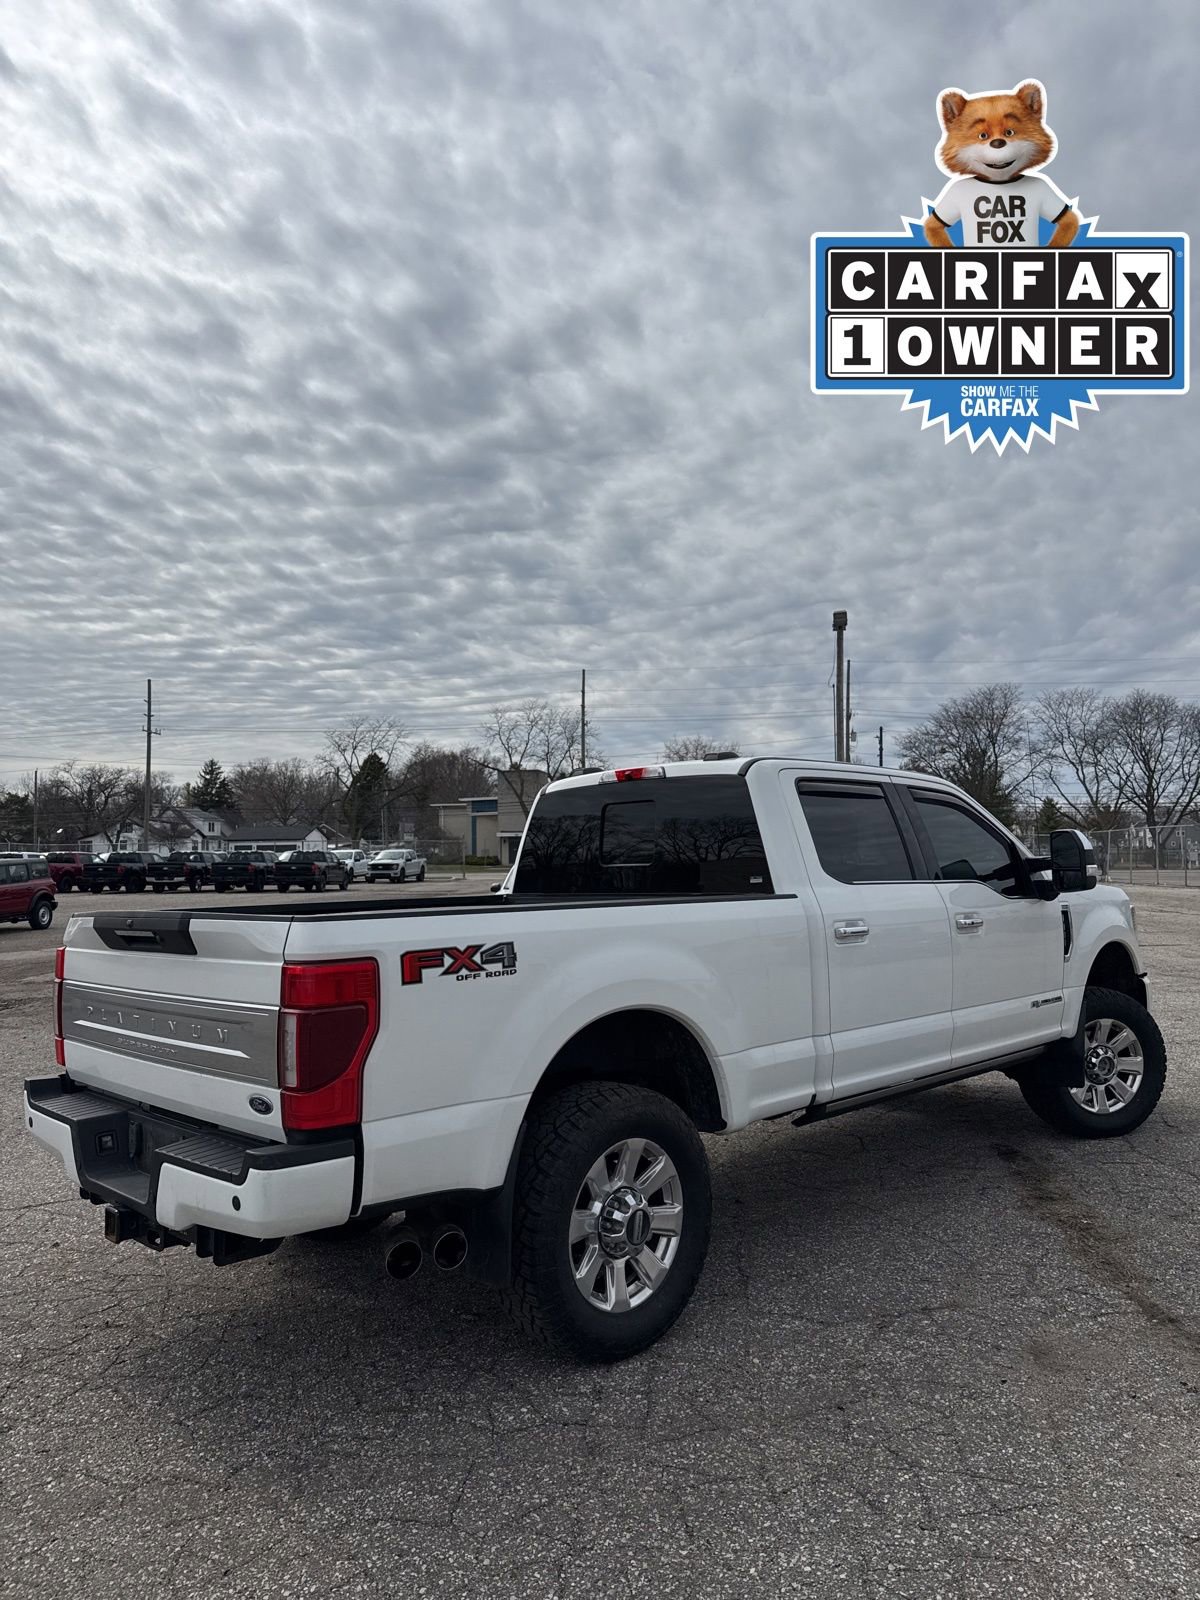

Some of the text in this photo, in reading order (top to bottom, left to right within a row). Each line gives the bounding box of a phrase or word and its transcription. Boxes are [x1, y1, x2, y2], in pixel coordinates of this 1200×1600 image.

[400, 941, 517, 987] FX4
[456, 968, 518, 982] OFF ROAD
[86, 1005, 230, 1043] PLATINUM
